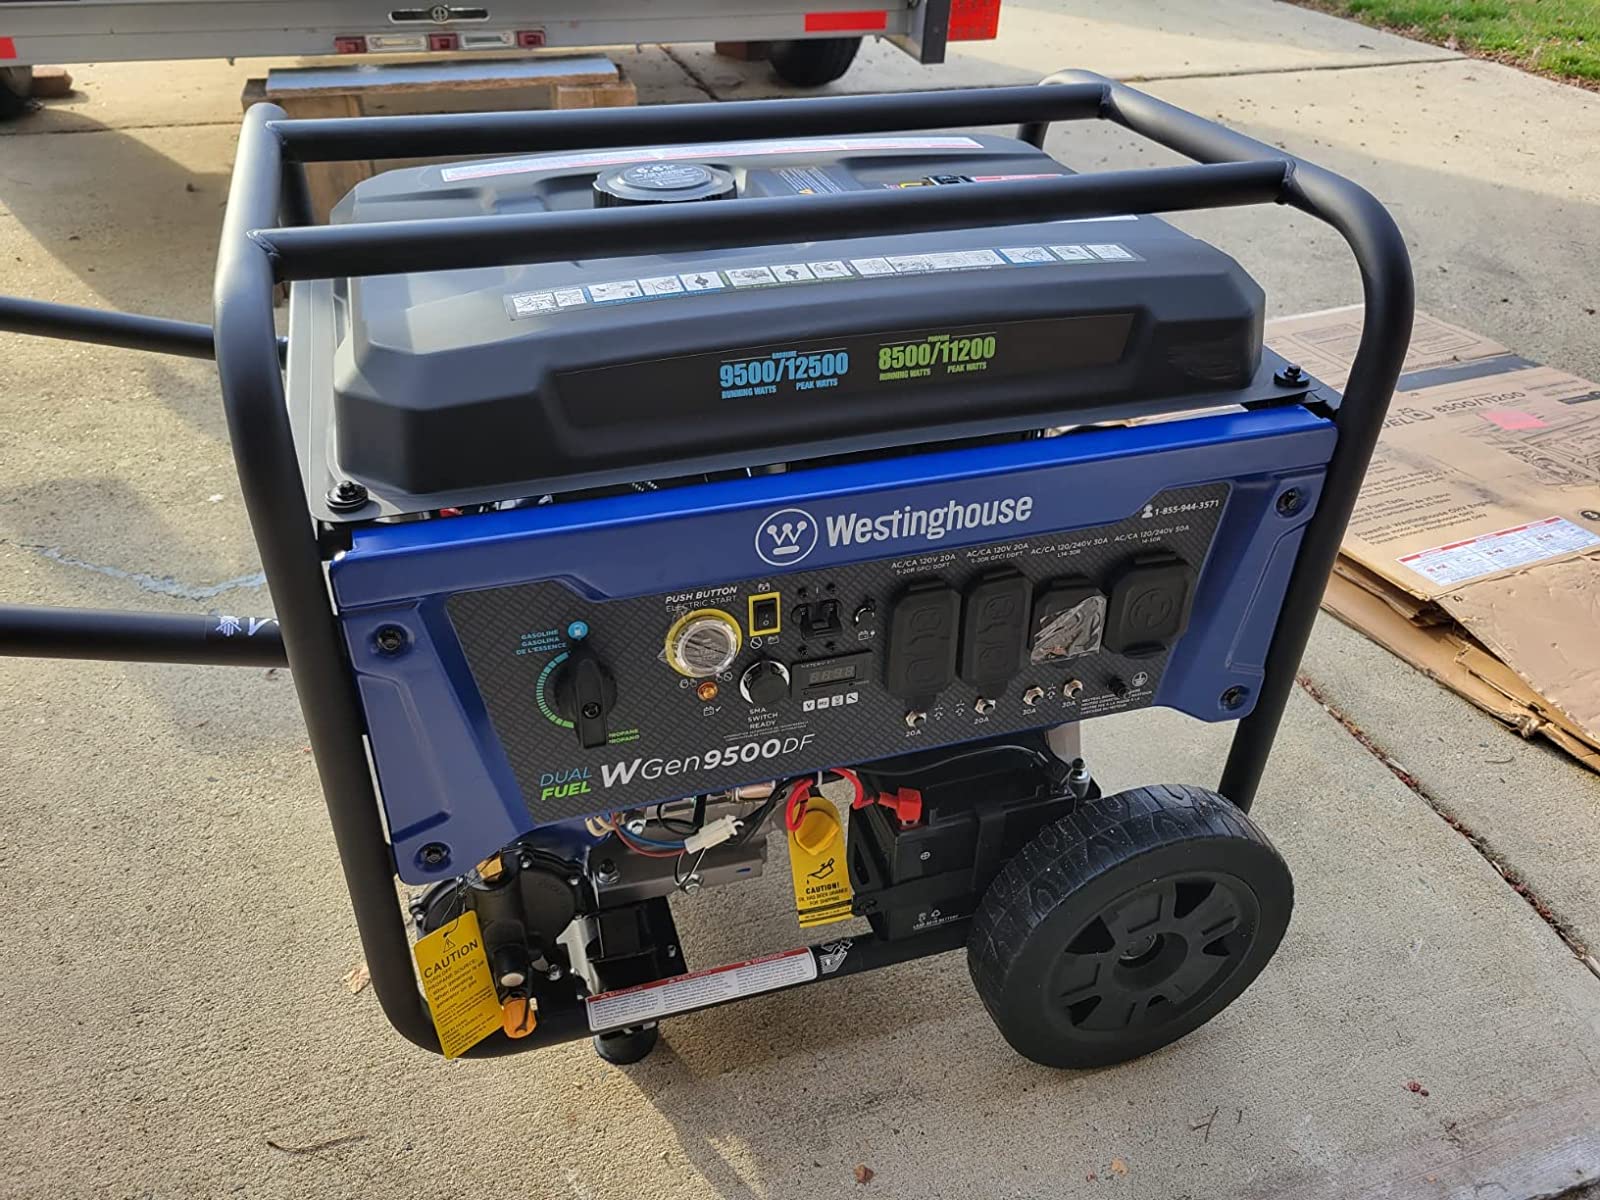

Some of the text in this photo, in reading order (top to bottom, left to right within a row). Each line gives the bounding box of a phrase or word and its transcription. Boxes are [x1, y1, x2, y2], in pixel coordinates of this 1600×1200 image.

[878, 336, 996, 370] 8500/11200
[720, 352, 848, 388] 9500/12500
[910, 368, 931, 378] WATTS
[947, 361, 987, 374] PEAK WATTS
[754, 385, 776, 396] WATTS
[796, 378, 838, 390] PEAK WATTS
[1432, 392, 1528, 414] 8500/11200
[1154, 500, 1220, 516] 1-855-944-3571
[826, 496, 1033, 546] Westinghouse
[1114, 524, 1190, 542] AC/CA 120/240V 50A
[966, 542, 1029, 558] AC/CA 120V 20A
[1031, 544, 1056, 555] AC/CA
[1057, 540, 1092, 552] 120/240V
[892, 553, 956, 570] AC/CA 120V 20A
[666, 586, 738, 604] PUSH BUTTON
[666, 596, 737, 613] ELECTRIC START
[520, 630, 559, 640] GASOLINE
[521, 637, 560, 648] GASOLINA
[516, 648, 526, 656] DE
[748, 712, 778, 722] SWITCH
[750, 720, 778, 729] READY
[974, 716, 990, 724] 20A
[906, 729, 922, 738] 20A
[540, 766, 592, 787] DUAL
[542, 781, 591, 800] FUEL
[806, 882, 840, 895] CAUTION!
[424, 939, 478, 978] CAUTION
